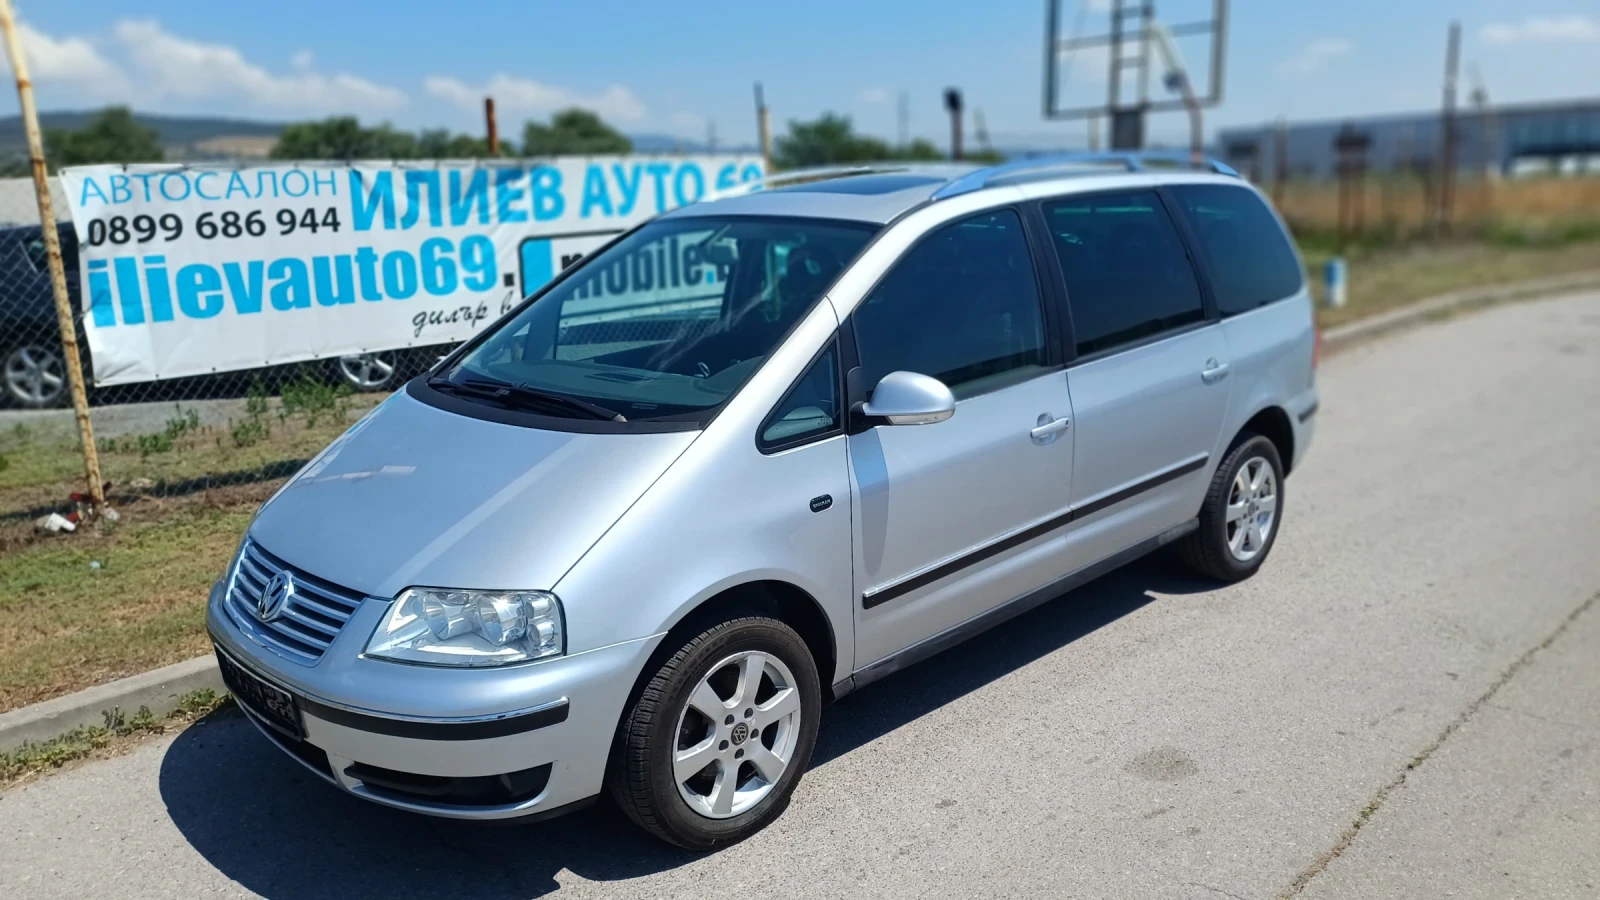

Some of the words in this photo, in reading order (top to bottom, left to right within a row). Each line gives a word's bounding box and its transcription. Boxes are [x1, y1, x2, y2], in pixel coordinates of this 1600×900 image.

[80, 170, 337, 206] АВТОСАЛОН
[349, 166, 565, 231] ИЛИЕВ
[580, 162, 705, 219] АУТО
[87, 213, 183, 246] 0899
[196, 211, 266, 240] 686
[275, 207, 341, 236] 944
[412, 301, 489, 338] дилър
